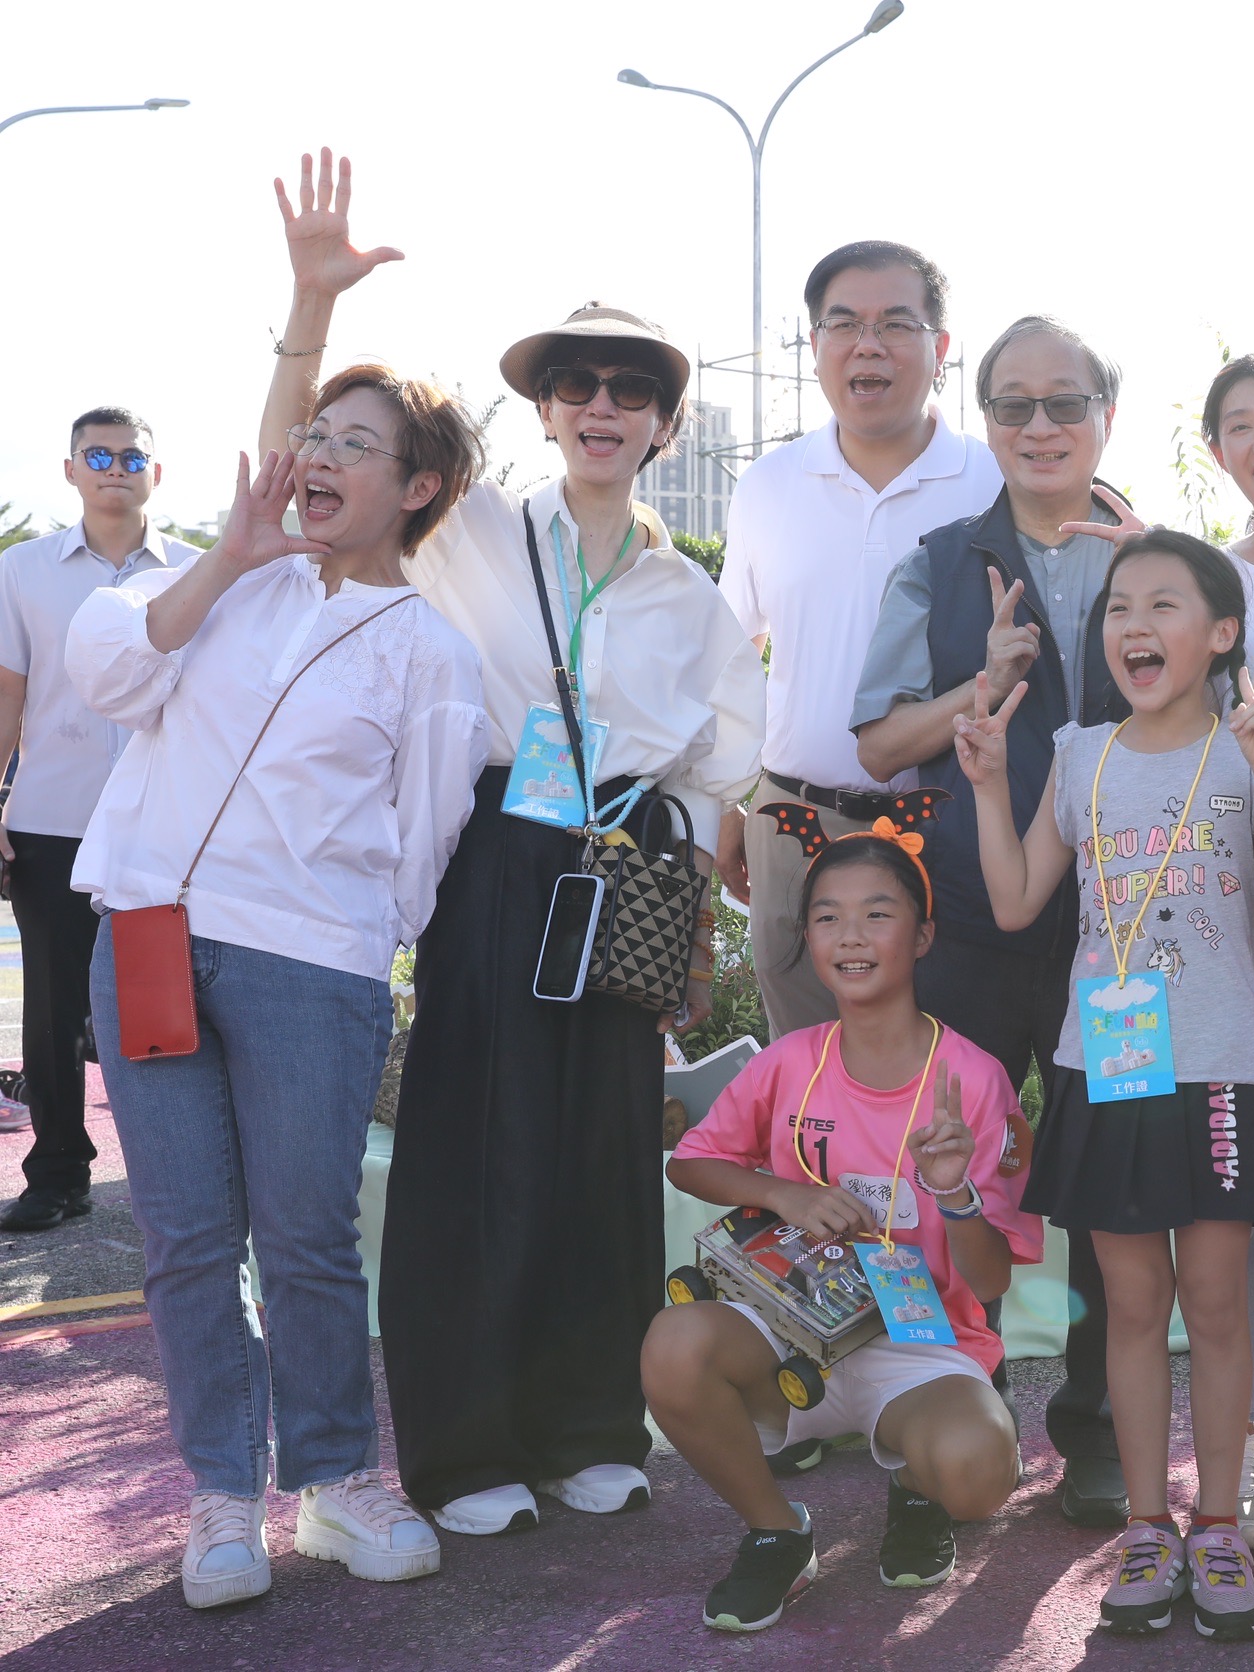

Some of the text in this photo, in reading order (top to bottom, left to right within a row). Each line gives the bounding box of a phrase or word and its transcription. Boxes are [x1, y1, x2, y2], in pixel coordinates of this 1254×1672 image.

[1080, 820, 1215, 869] YOU ARE
[1093, 863, 1206, 910] SUPER!
[1187, 907, 1225, 951] COOL
[1111, 1080, 1149, 1095] 工作證
[907, 1329, 936, 1340] 工作證
